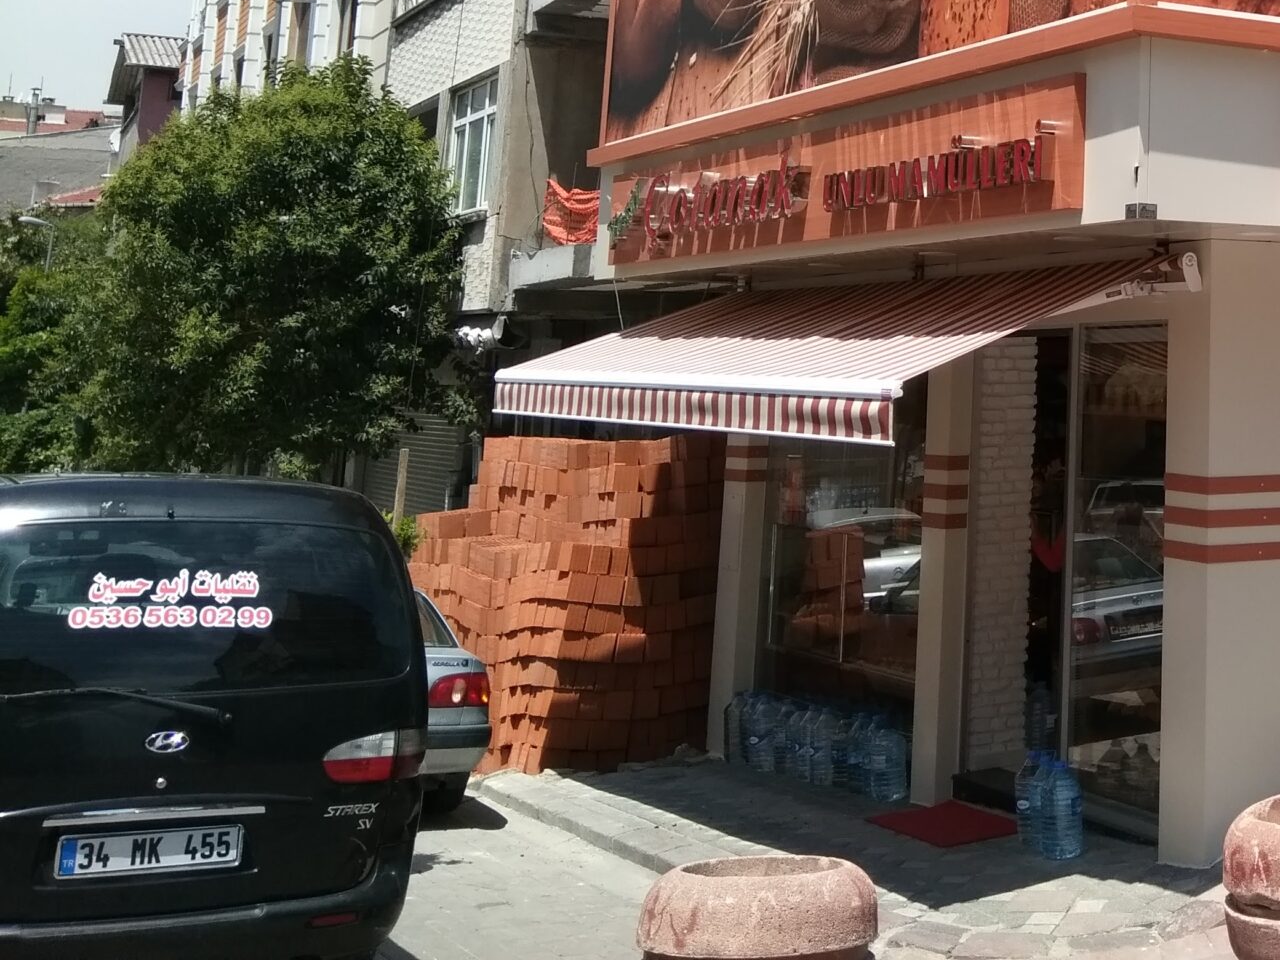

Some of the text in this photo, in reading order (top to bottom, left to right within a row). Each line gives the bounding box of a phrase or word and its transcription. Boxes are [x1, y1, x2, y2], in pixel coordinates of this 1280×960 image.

[89, 568, 260, 604] نقليات أبو حسين
[68, 606, 272, 628] 0536 563 02 99
[323, 802, 381, 818] STAREX
[357, 818, 374, 830] SV
[78, 831, 232, 870] 34 MK 455
[62, 858, 75, 868] TR
